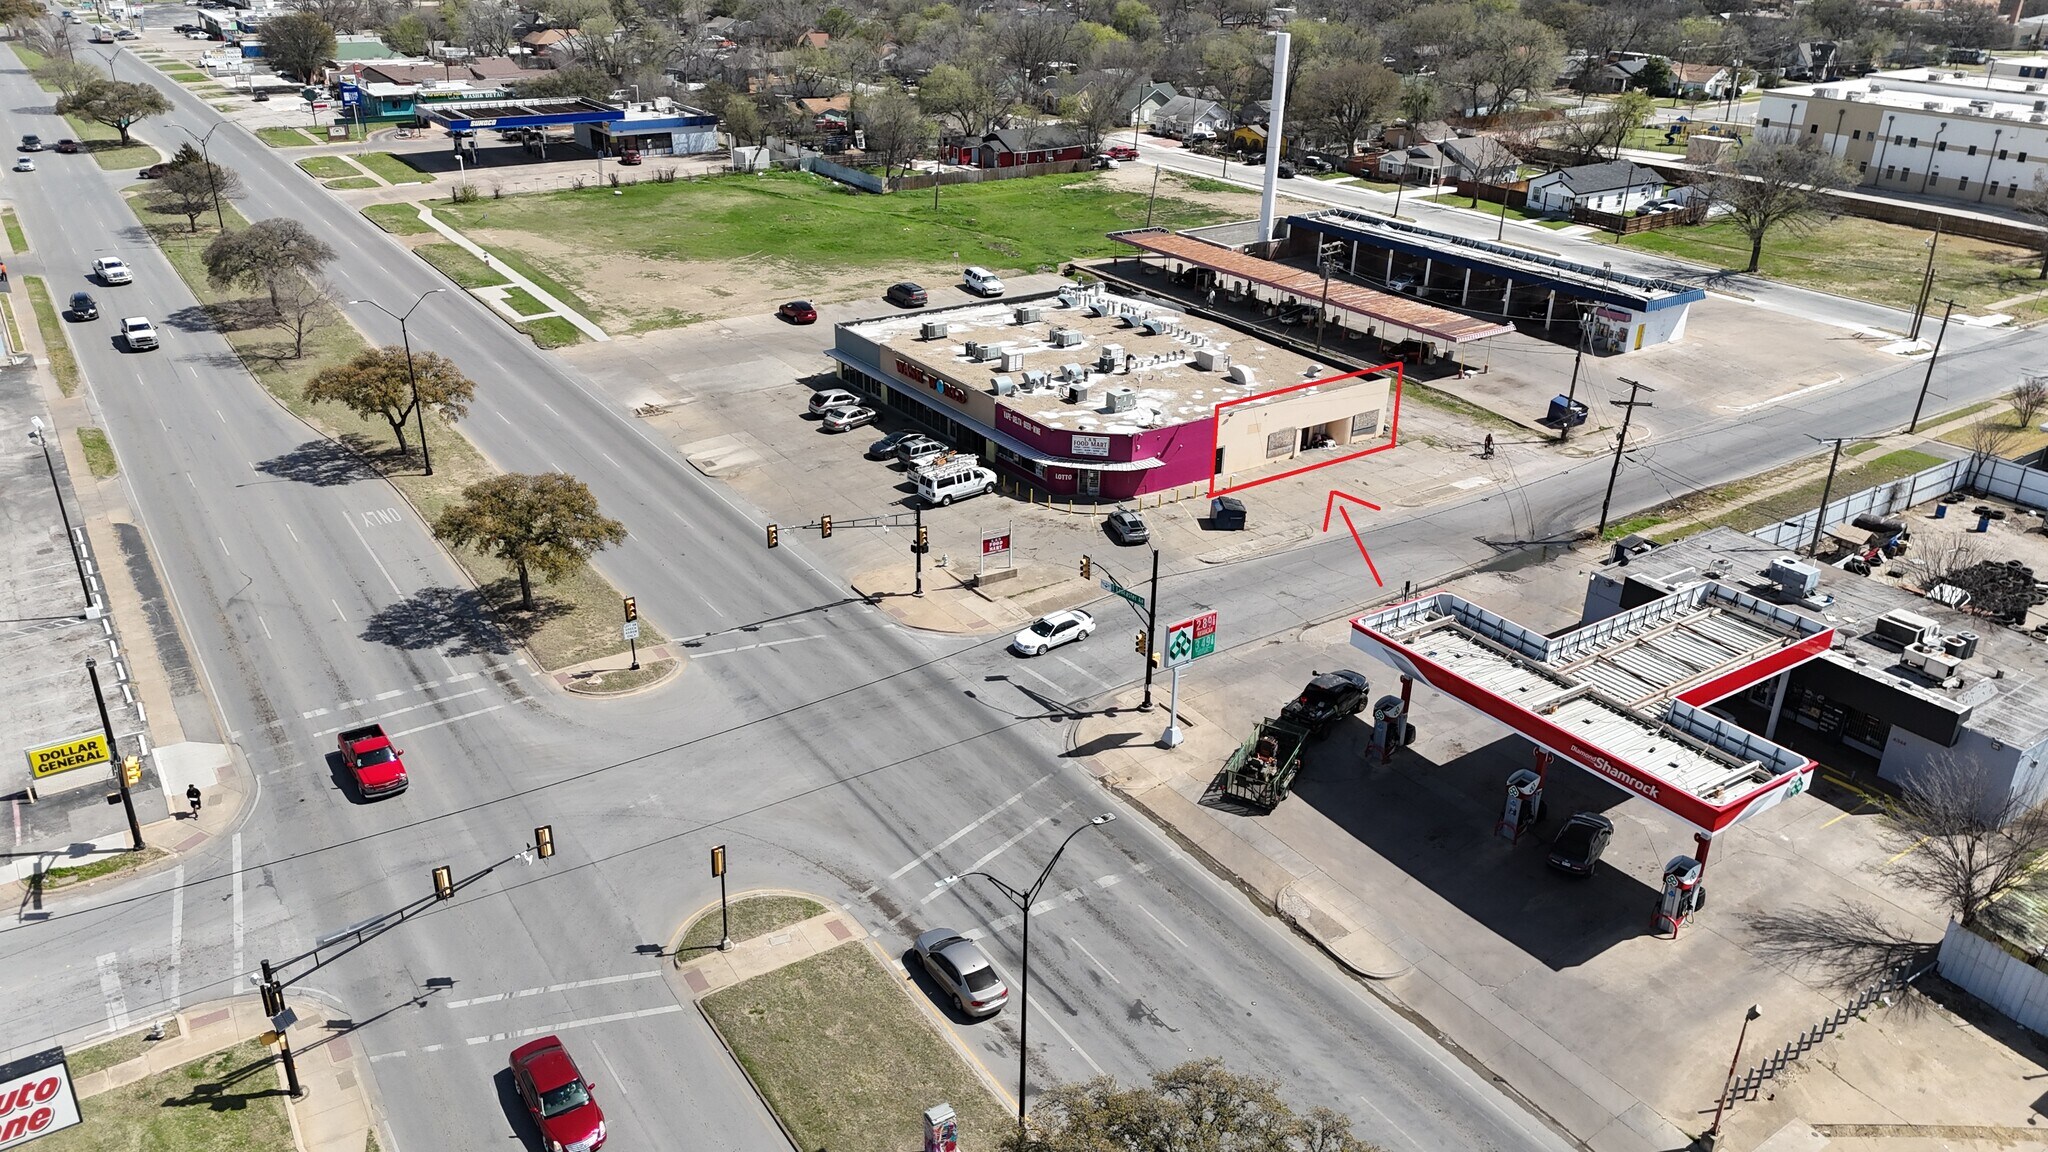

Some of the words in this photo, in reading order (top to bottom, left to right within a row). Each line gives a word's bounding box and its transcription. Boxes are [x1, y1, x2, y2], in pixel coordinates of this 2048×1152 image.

[470, 119, 497, 127] SUNOCO
[361, 507, 402, 528] ONLY
[38, 750, 104, 773] GENERAL
[39, 741, 98, 762] DOLLAR
[1570, 744, 1598, 763] Diamond
[1594, 756, 1660, 799] Shamrock
[0, 1076, 60, 1116] uto
[0, 1107, 54, 1143] ne
